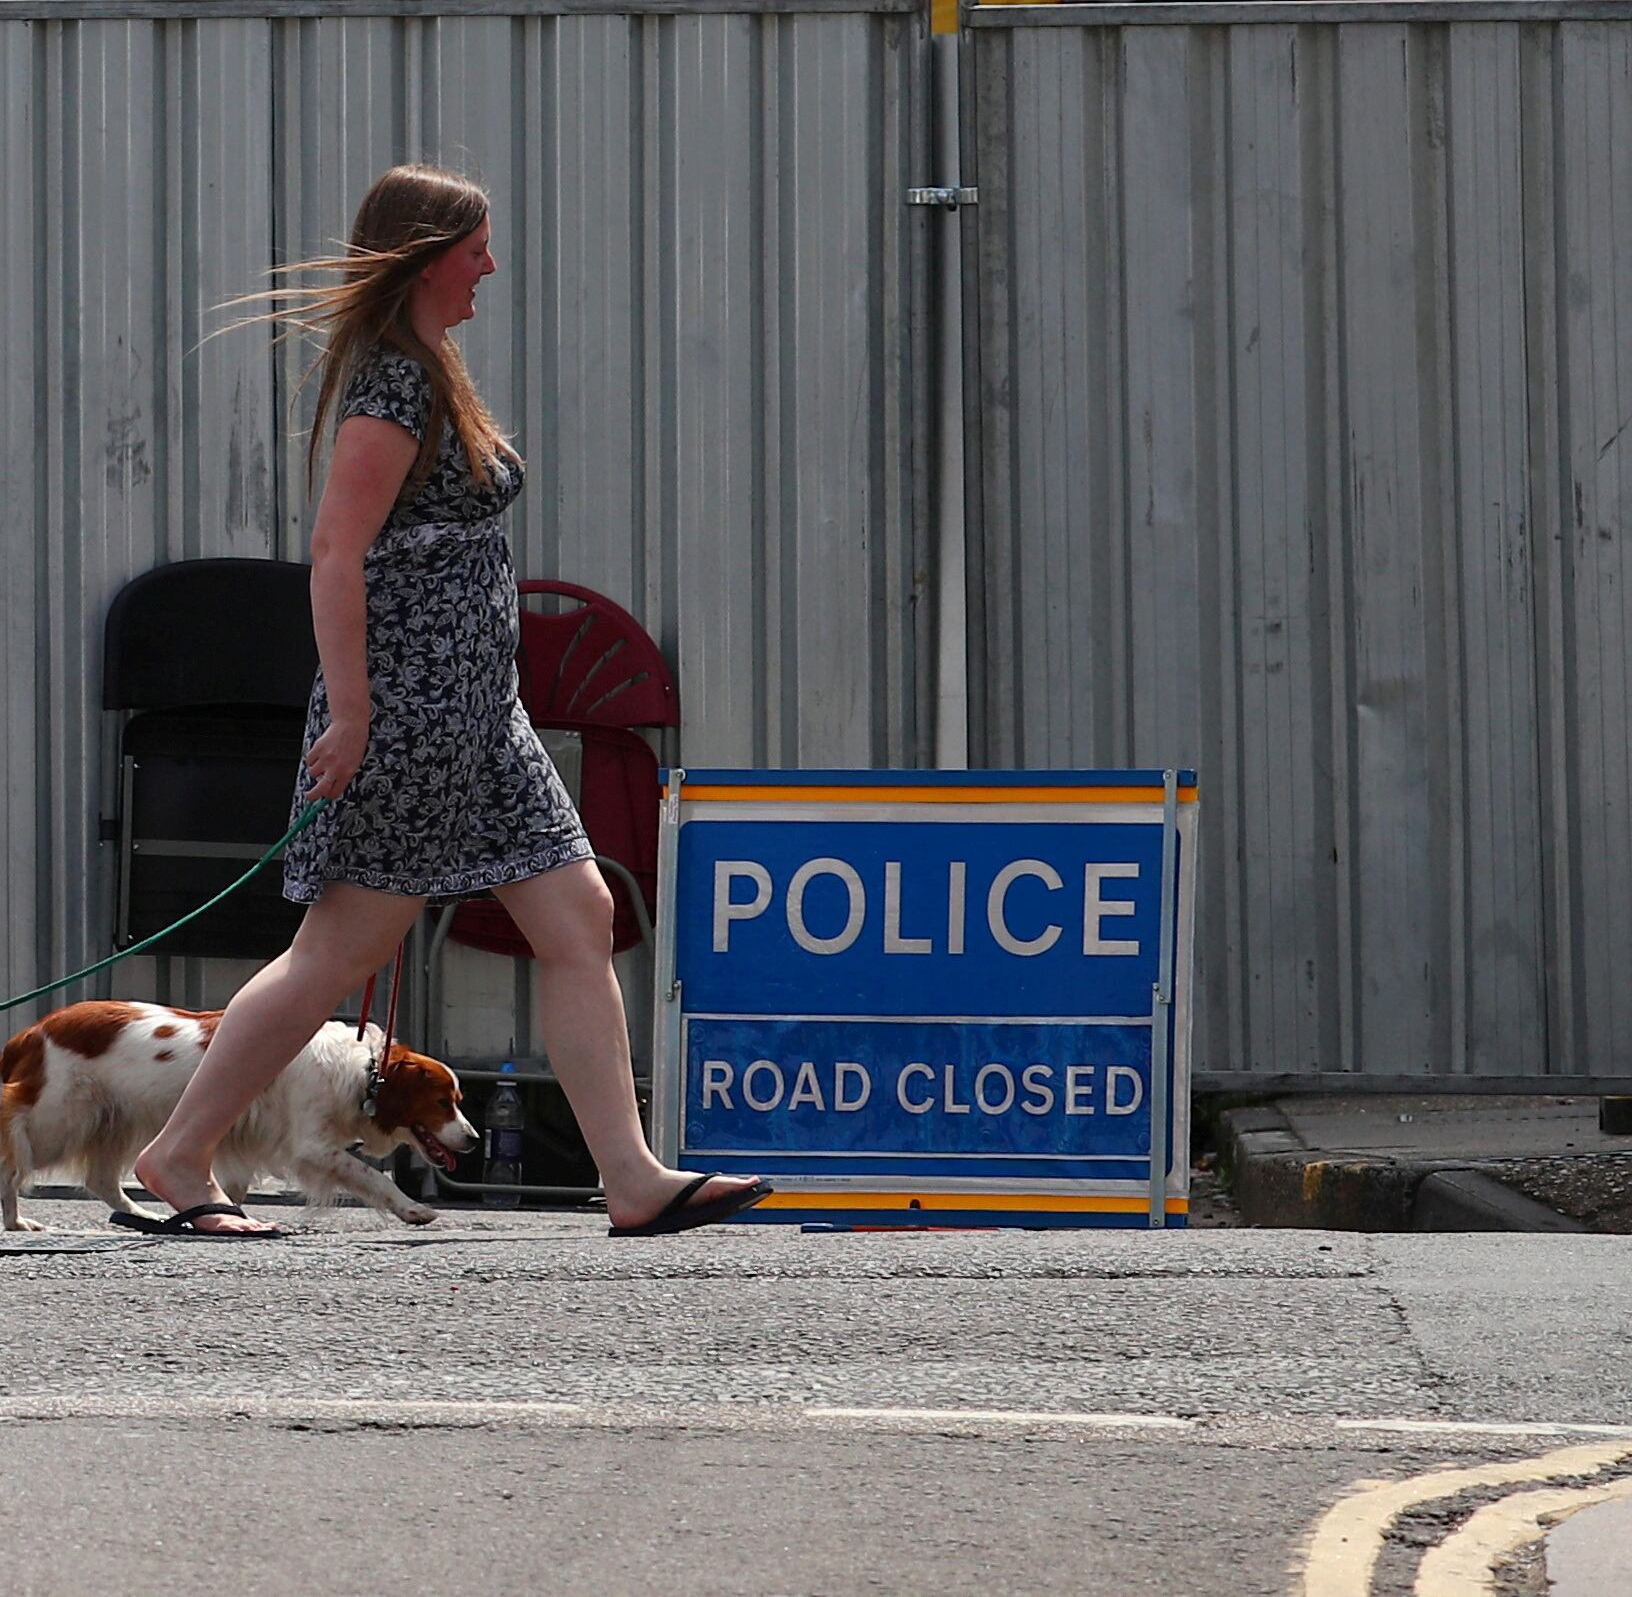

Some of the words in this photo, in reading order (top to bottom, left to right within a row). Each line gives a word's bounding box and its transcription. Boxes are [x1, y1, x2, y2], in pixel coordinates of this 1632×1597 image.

[712, 857, 1140, 956] POLICE
[702, 1060, 872, 1112] ROAD
[896, 1063, 1144, 1116] CLOSED
